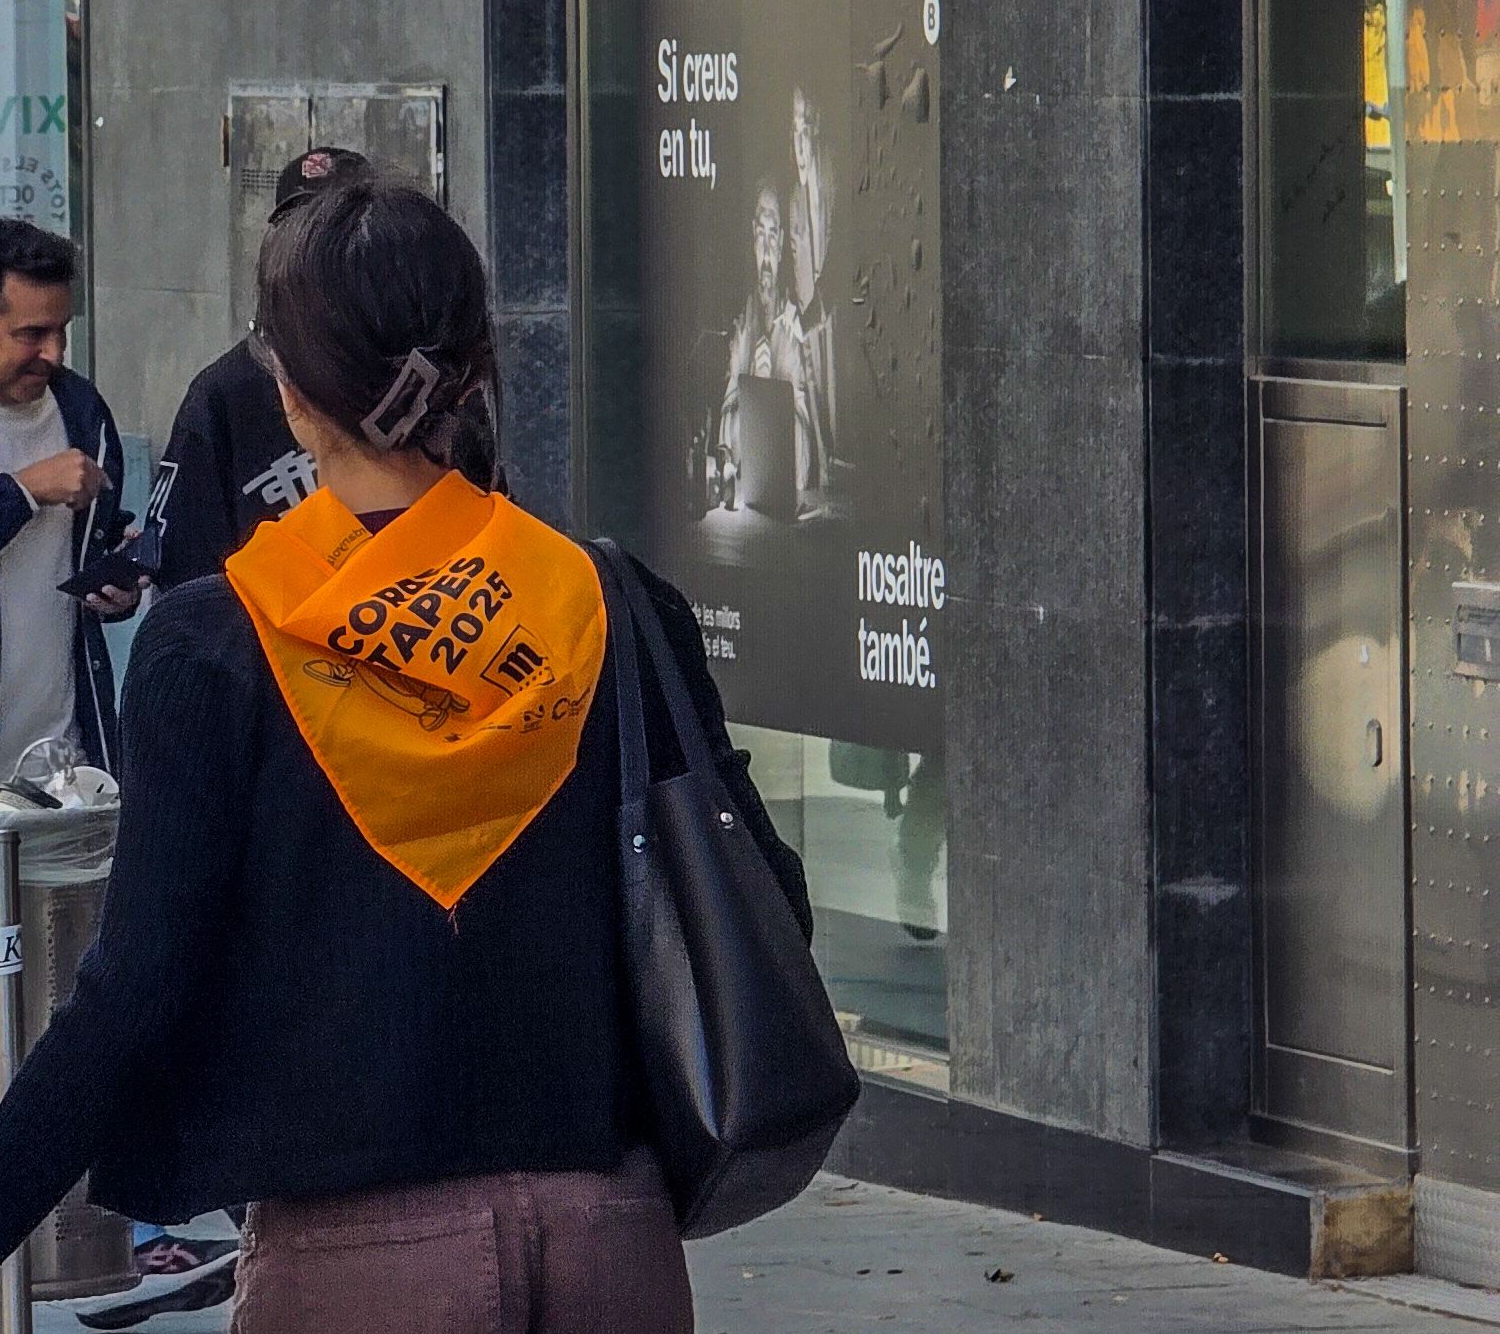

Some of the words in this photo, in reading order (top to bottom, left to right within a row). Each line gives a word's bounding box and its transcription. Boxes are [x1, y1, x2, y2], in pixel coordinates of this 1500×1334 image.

[657, 38, 678, 103] Si
[683, 52, 739, 103] creus
[659, 128, 684, 179] en
[689, 118, 717, 190] tu,
[858, 540, 945, 610] nosaltre
[364, 556, 486, 672] TAPES
[429, 570, 514, 676] 2025
[858, 617, 936, 689] també.
